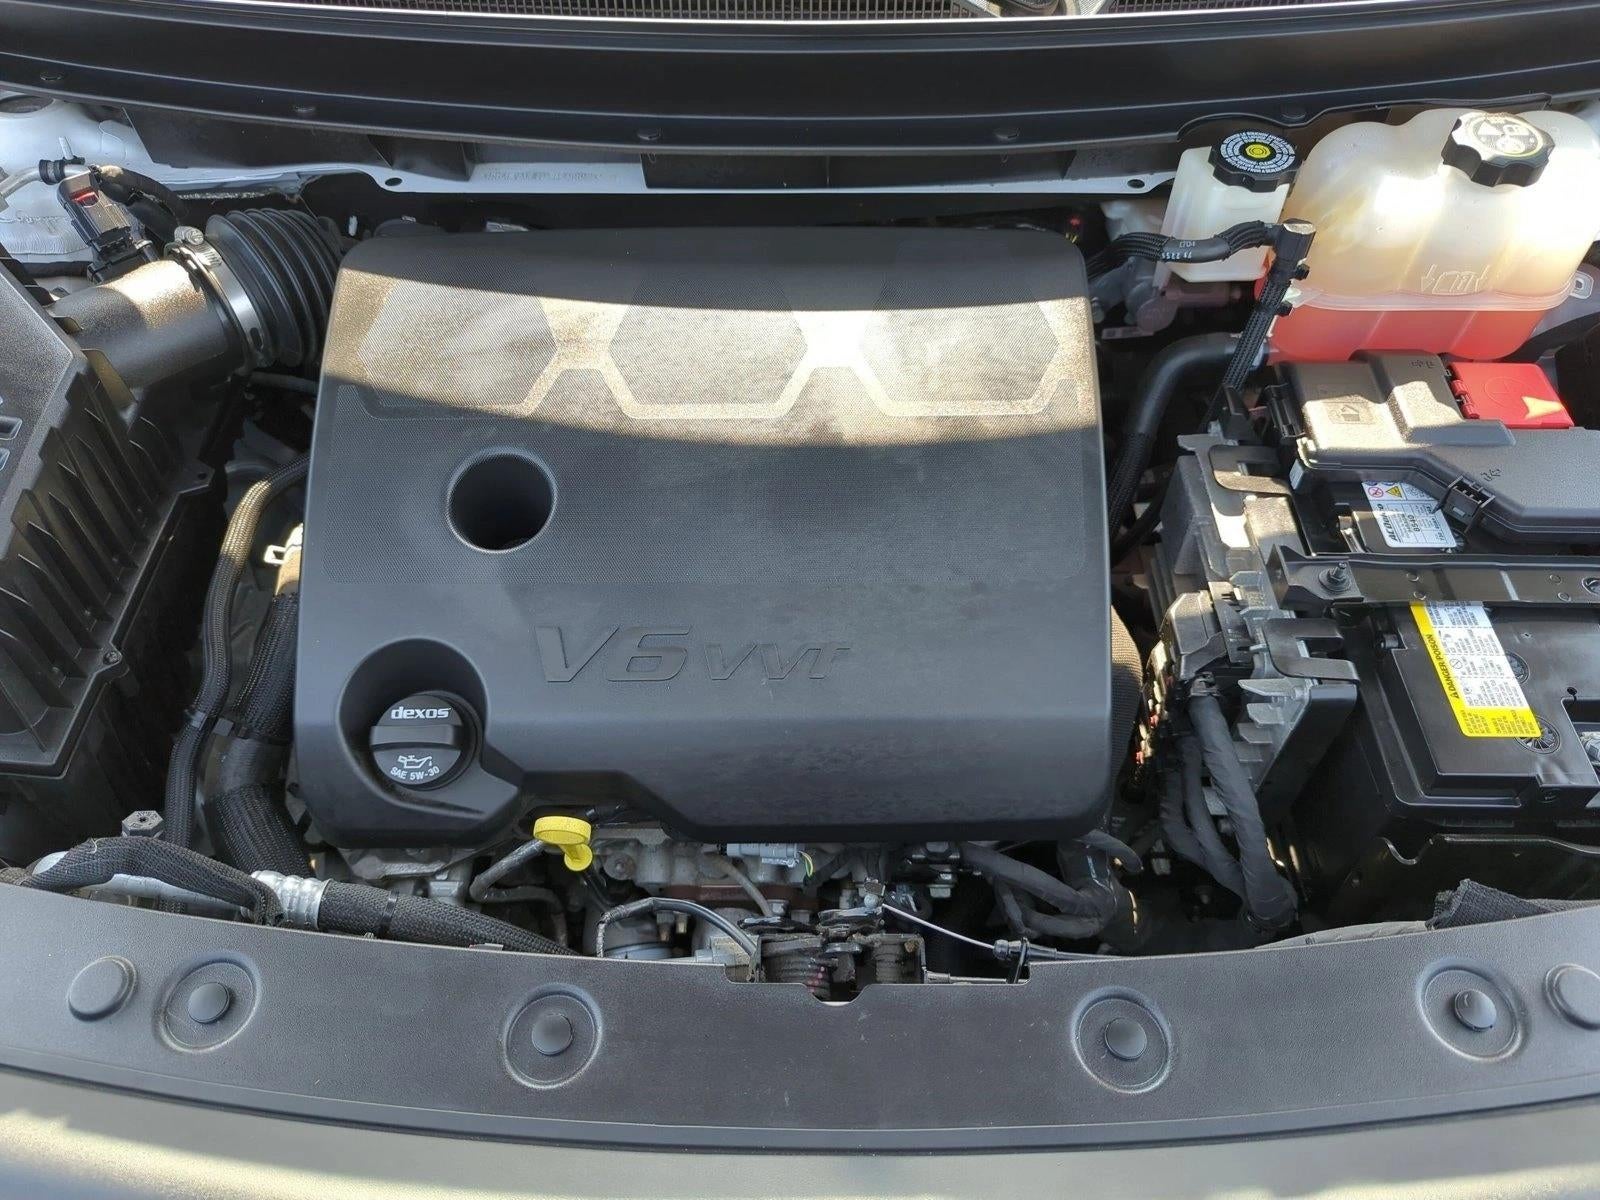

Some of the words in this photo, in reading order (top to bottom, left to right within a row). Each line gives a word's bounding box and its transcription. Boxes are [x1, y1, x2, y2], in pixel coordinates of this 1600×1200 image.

[1377, 503, 1398, 542] ACDelo
[535, 626, 692, 682] V6
[704, 643, 850, 680] VVT
[1426, 633, 1443, 660] POISON
[1438, 661, 1456, 693] DANGER
[391, 706, 452, 719] dexos
[390, 766, 408, 779] SAE
[410, 766, 440, 780] 5W-30
